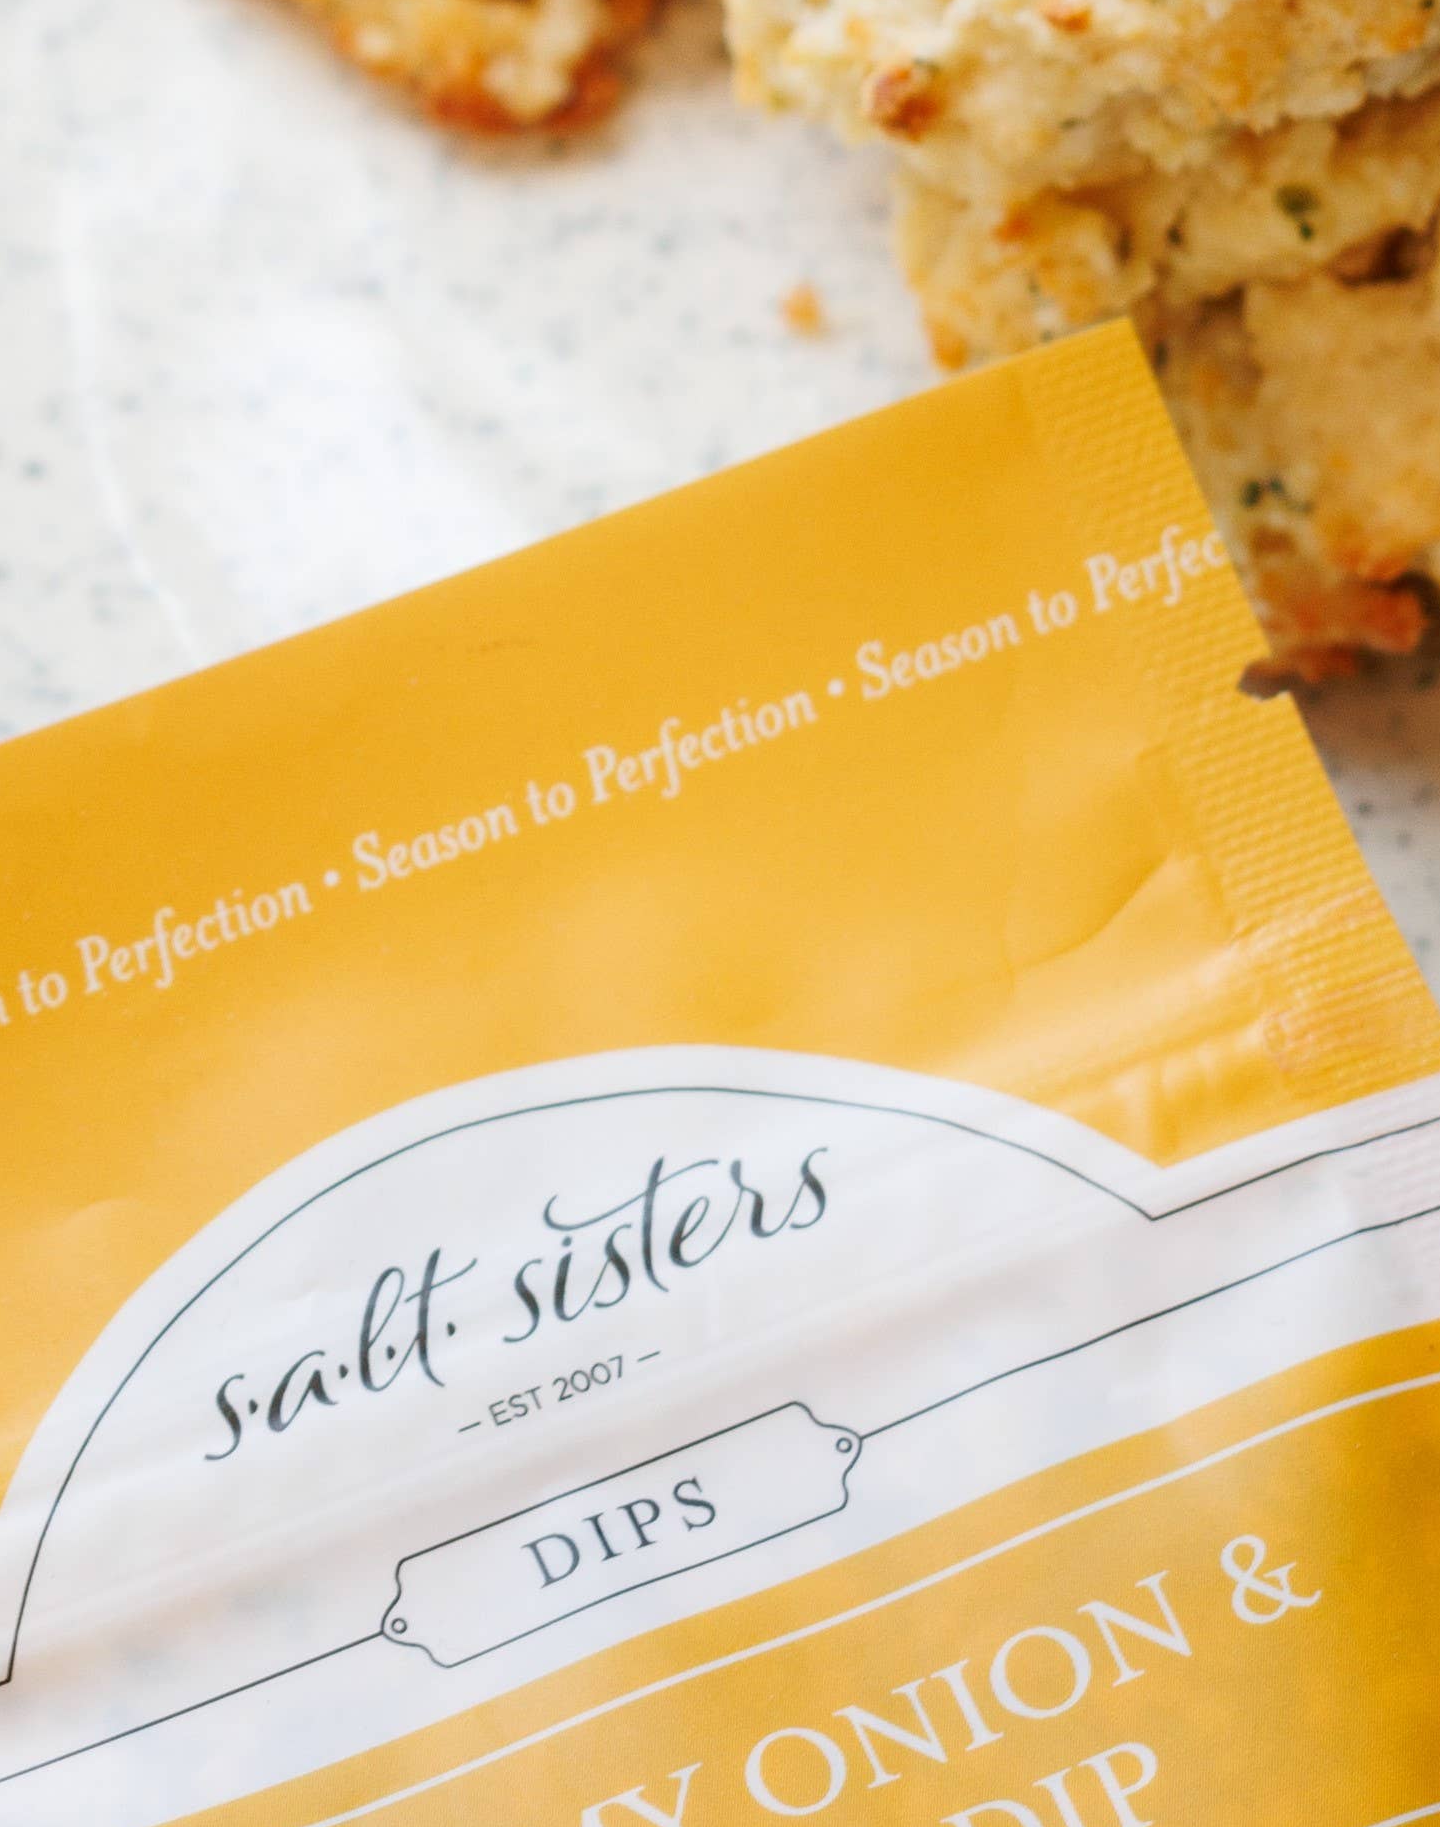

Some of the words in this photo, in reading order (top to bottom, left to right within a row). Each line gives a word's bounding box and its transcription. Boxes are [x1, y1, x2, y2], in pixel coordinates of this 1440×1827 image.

[19, 968, 67, 1014] to
[76, 877, 312, 990] Perfection
[352, 801, 519, 891] Season
[526, 779, 576, 826] to
[583, 688, 817, 802] Perfection
[855, 612, 1021, 700] Season
[1027, 589, 1079, 636] to
[503, 1146, 829, 1344] sisters
[489, 1385, 544, 1427] EST
[557, 1354, 626, 1403] 2007
[522, 1477, 718, 1589] DIPS
[744, 1570, 1194, 1817] ONION
[1219, 1533, 1322, 1627] &
